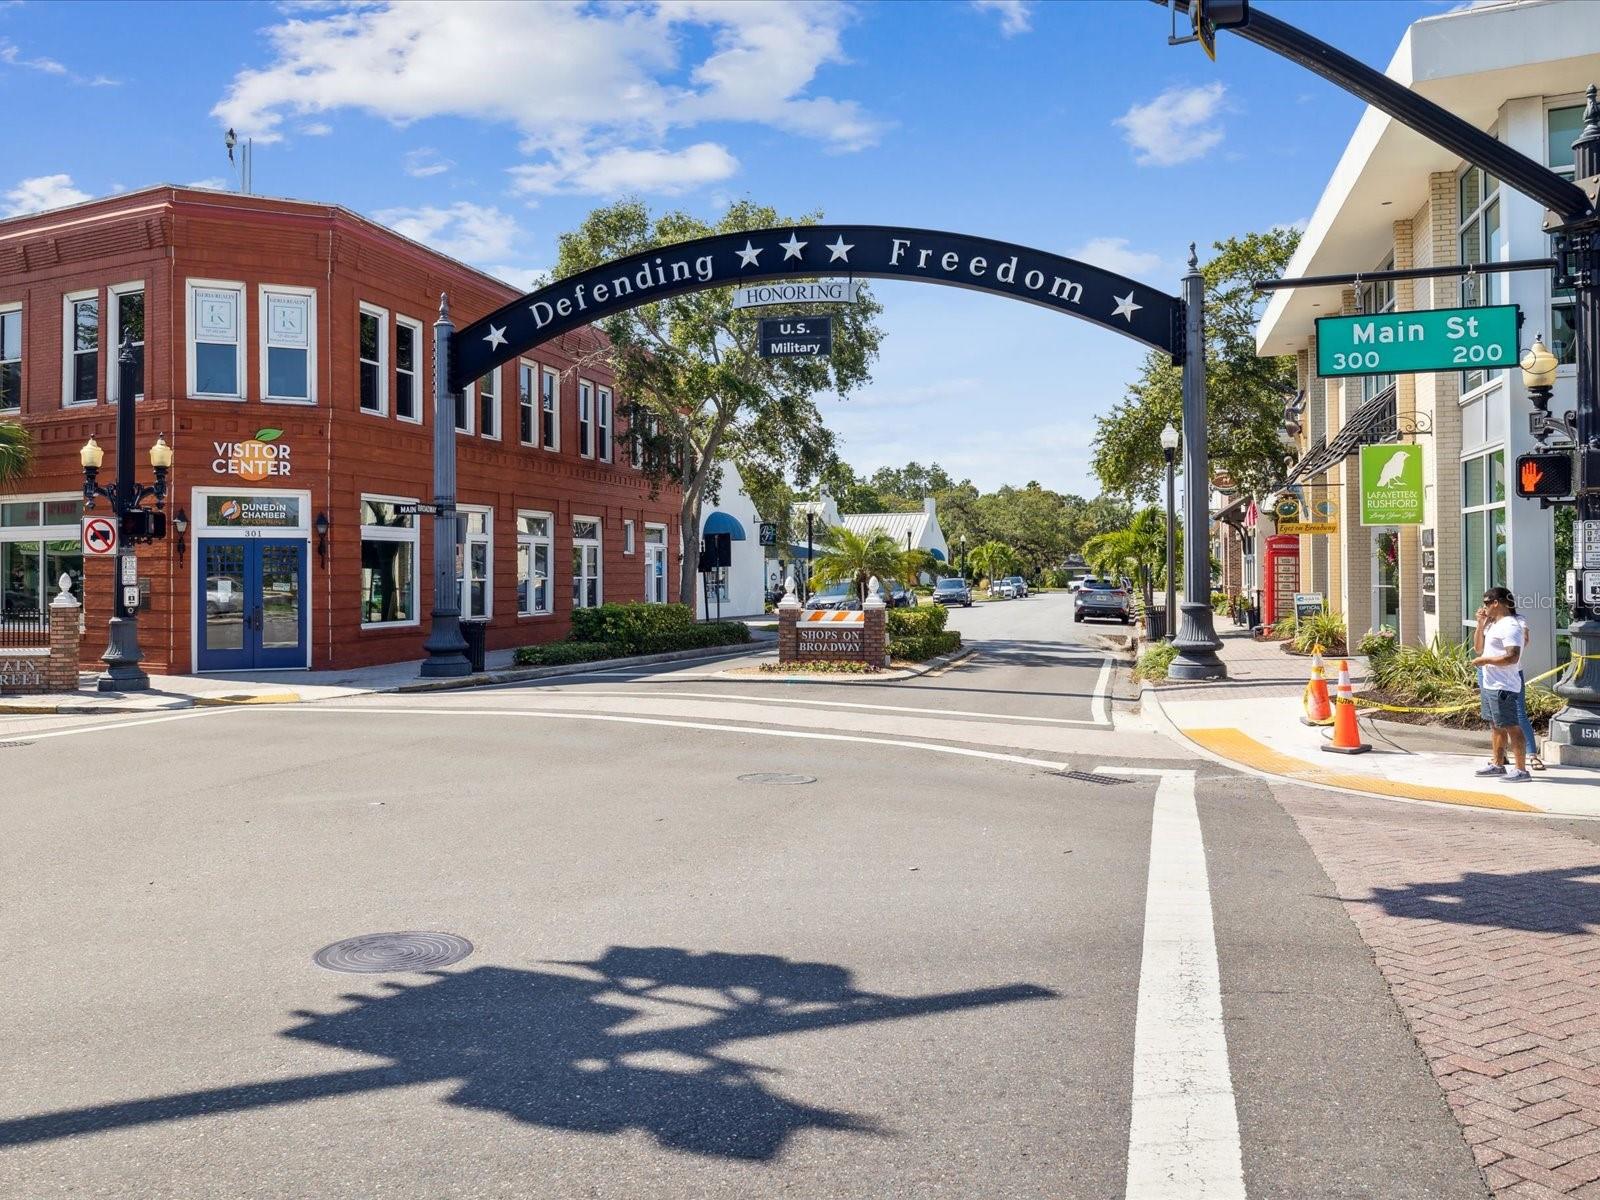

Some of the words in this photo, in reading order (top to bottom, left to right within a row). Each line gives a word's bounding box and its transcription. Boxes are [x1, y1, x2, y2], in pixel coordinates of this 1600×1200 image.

[529, 256, 713, 330] Defending
[889, 238, 1084, 304] Freedom
[747, 284, 842, 303] HONORING
[780, 323, 810, 335] U.S.
[1353, 321, 1424, 345] Main
[1446, 316, 1478, 339] St
[771, 343, 820, 354] Military
[1333, 351, 1380, 369] 300
[1453, 344, 1503, 363] 200
[213, 442, 291, 459] VISITOR
[212, 459, 291, 476] CENTER
[1368, 500, 1418, 508] RUSHFORD
[1280, 525, 1294, 533] Eyes
[1304, 524, 1337, 533] Broadway
[801, 630, 838, 640] SHOPS
[843, 631, 860, 640] ON
[799, 642, 861, 652] BROADWAY
[2, 660, 36, 671] AIN
[0, 672, 43, 686] REET
